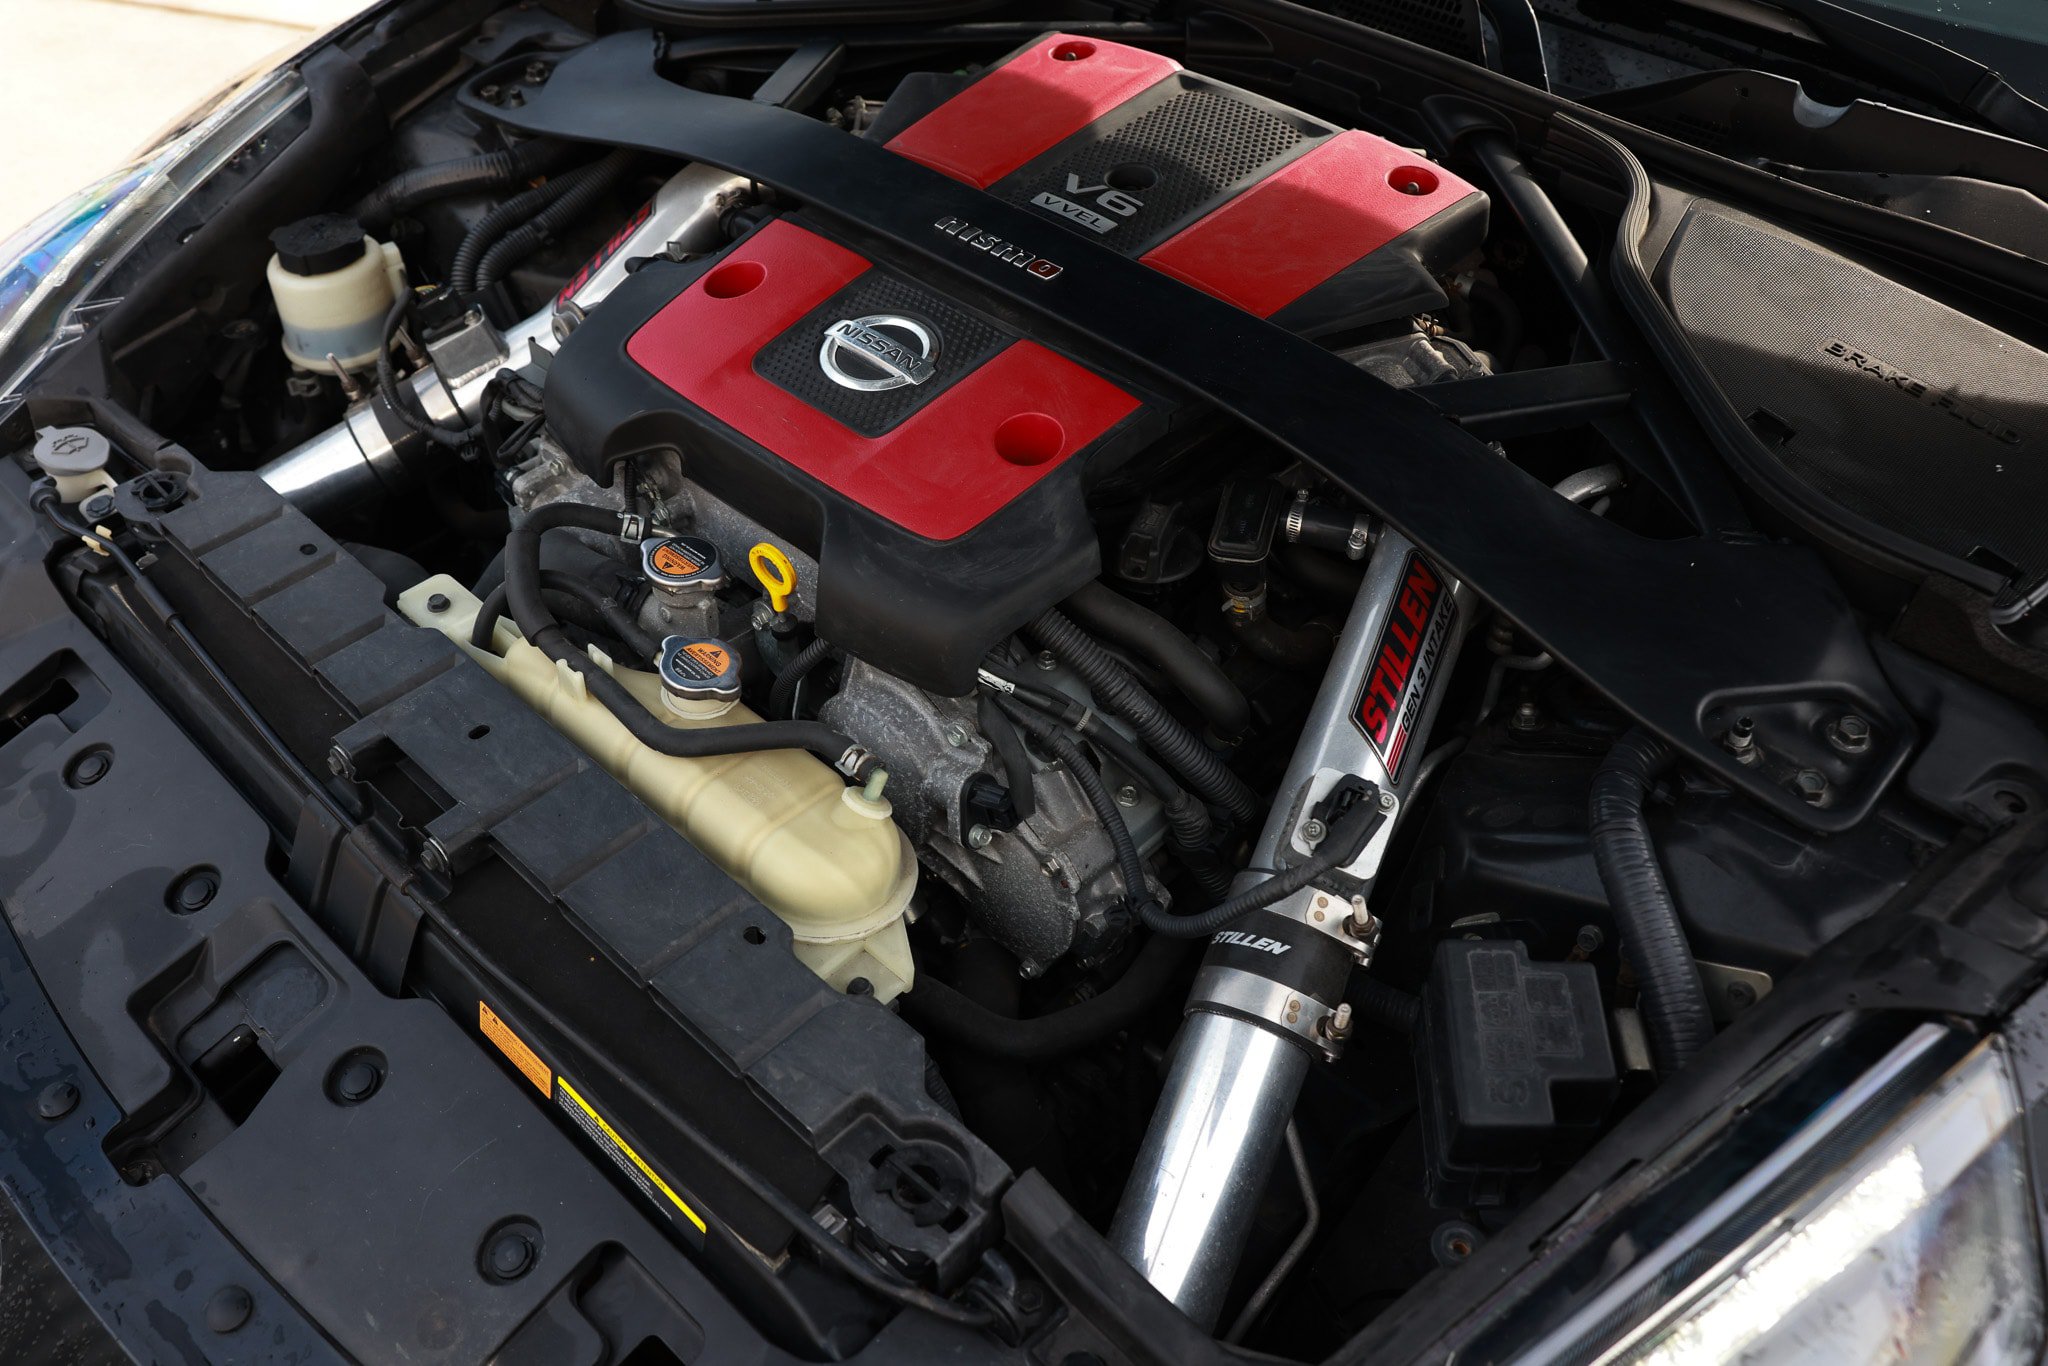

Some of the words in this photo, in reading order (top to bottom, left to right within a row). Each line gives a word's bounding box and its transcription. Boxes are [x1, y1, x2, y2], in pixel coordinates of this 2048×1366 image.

[1043, 195, 1102, 229] VVEL
[1066, 172, 1145, 217] V6
[836, 323, 922, 372] NISSAN
[1823, 341, 1927, 399] BRAKE
[1931, 391, 2021, 444] FLUID
[1361, 559, 1438, 744] STILLEN
[1402, 685, 1421, 733] GEN
[1417, 667, 1427, 688] 3
[1423, 593, 1453, 670] INTAKE
[1211, 930, 1292, 955] STILLEN
[603, 1123, 628, 1152] CAUTION
[633, 1155, 666, 1191] ATTENTION
